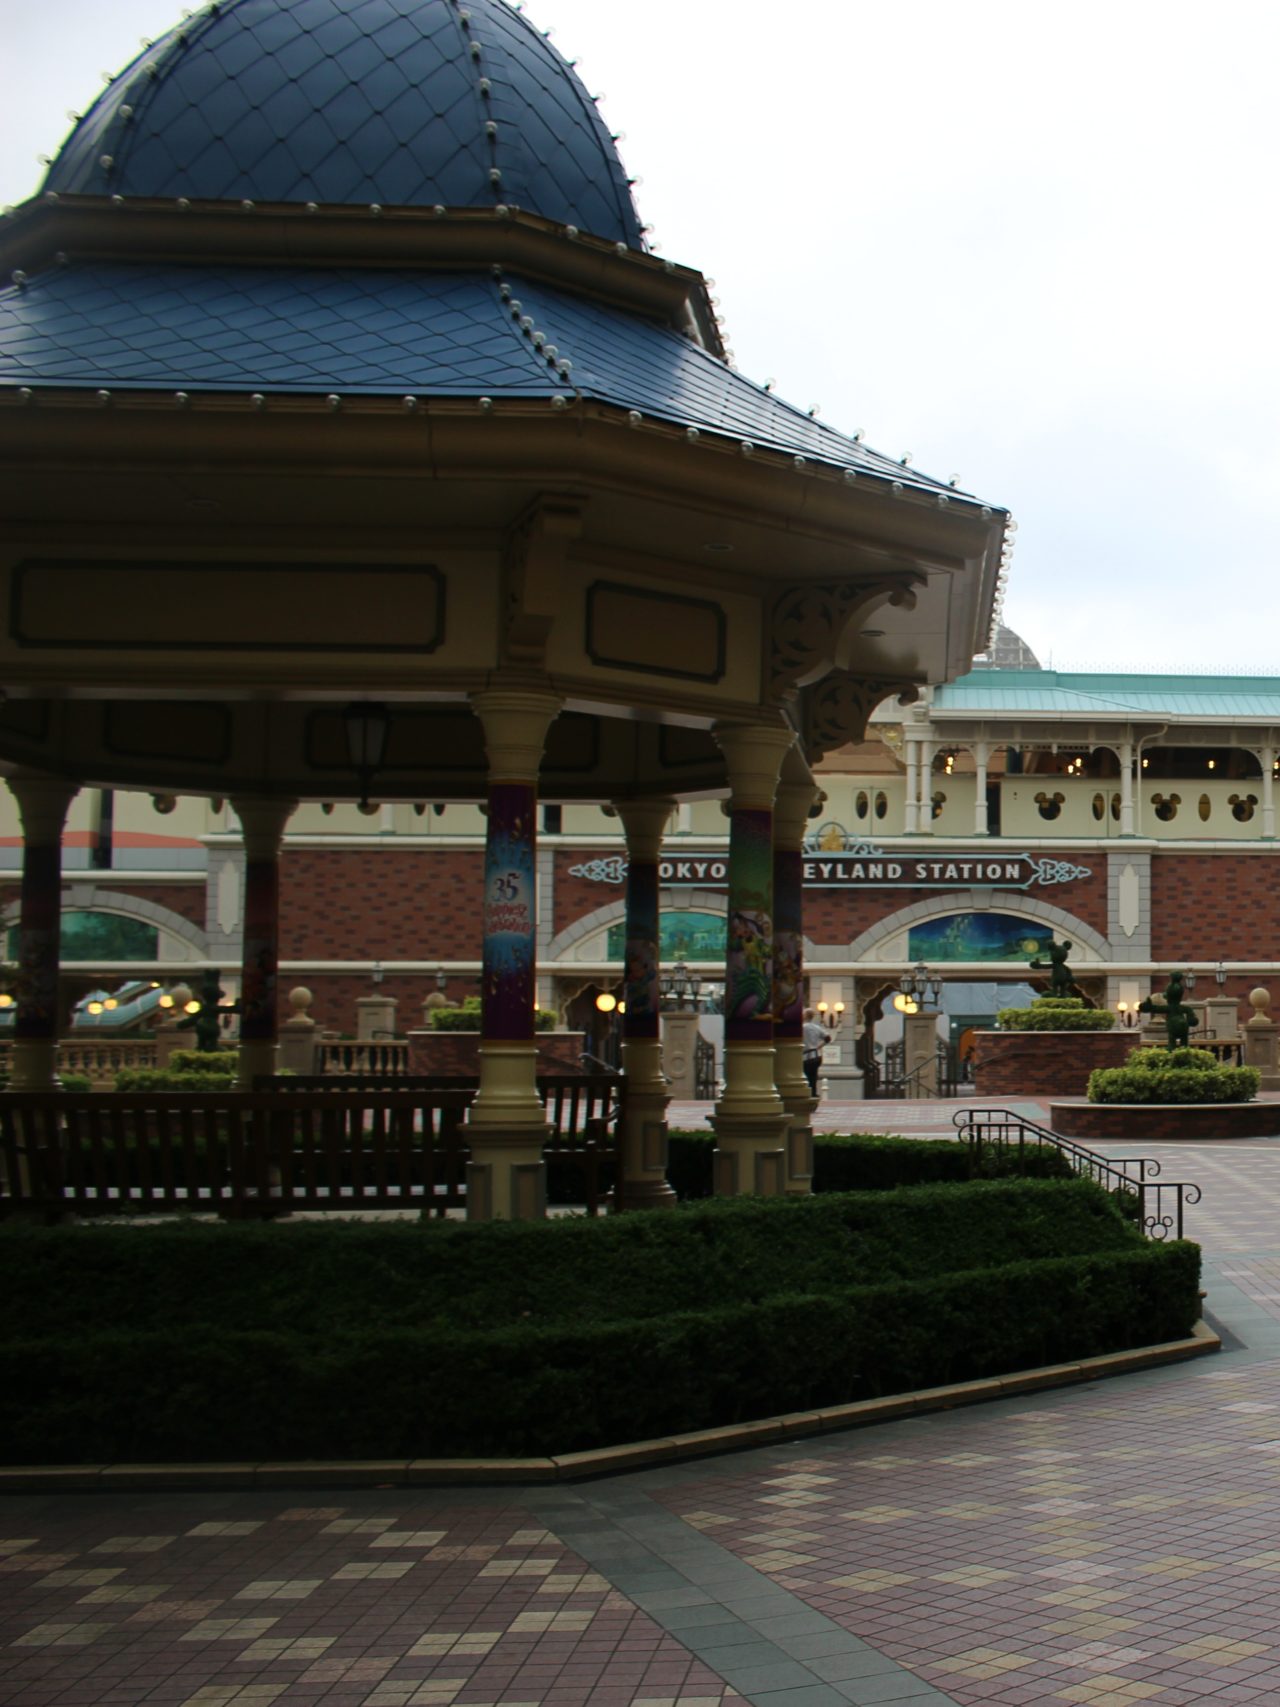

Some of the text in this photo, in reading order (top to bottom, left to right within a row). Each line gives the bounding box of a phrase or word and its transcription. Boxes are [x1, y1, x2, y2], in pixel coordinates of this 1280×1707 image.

[659, 863, 1020, 880] OKYO EYLAND STATION
[492, 872, 520, 902] 35
